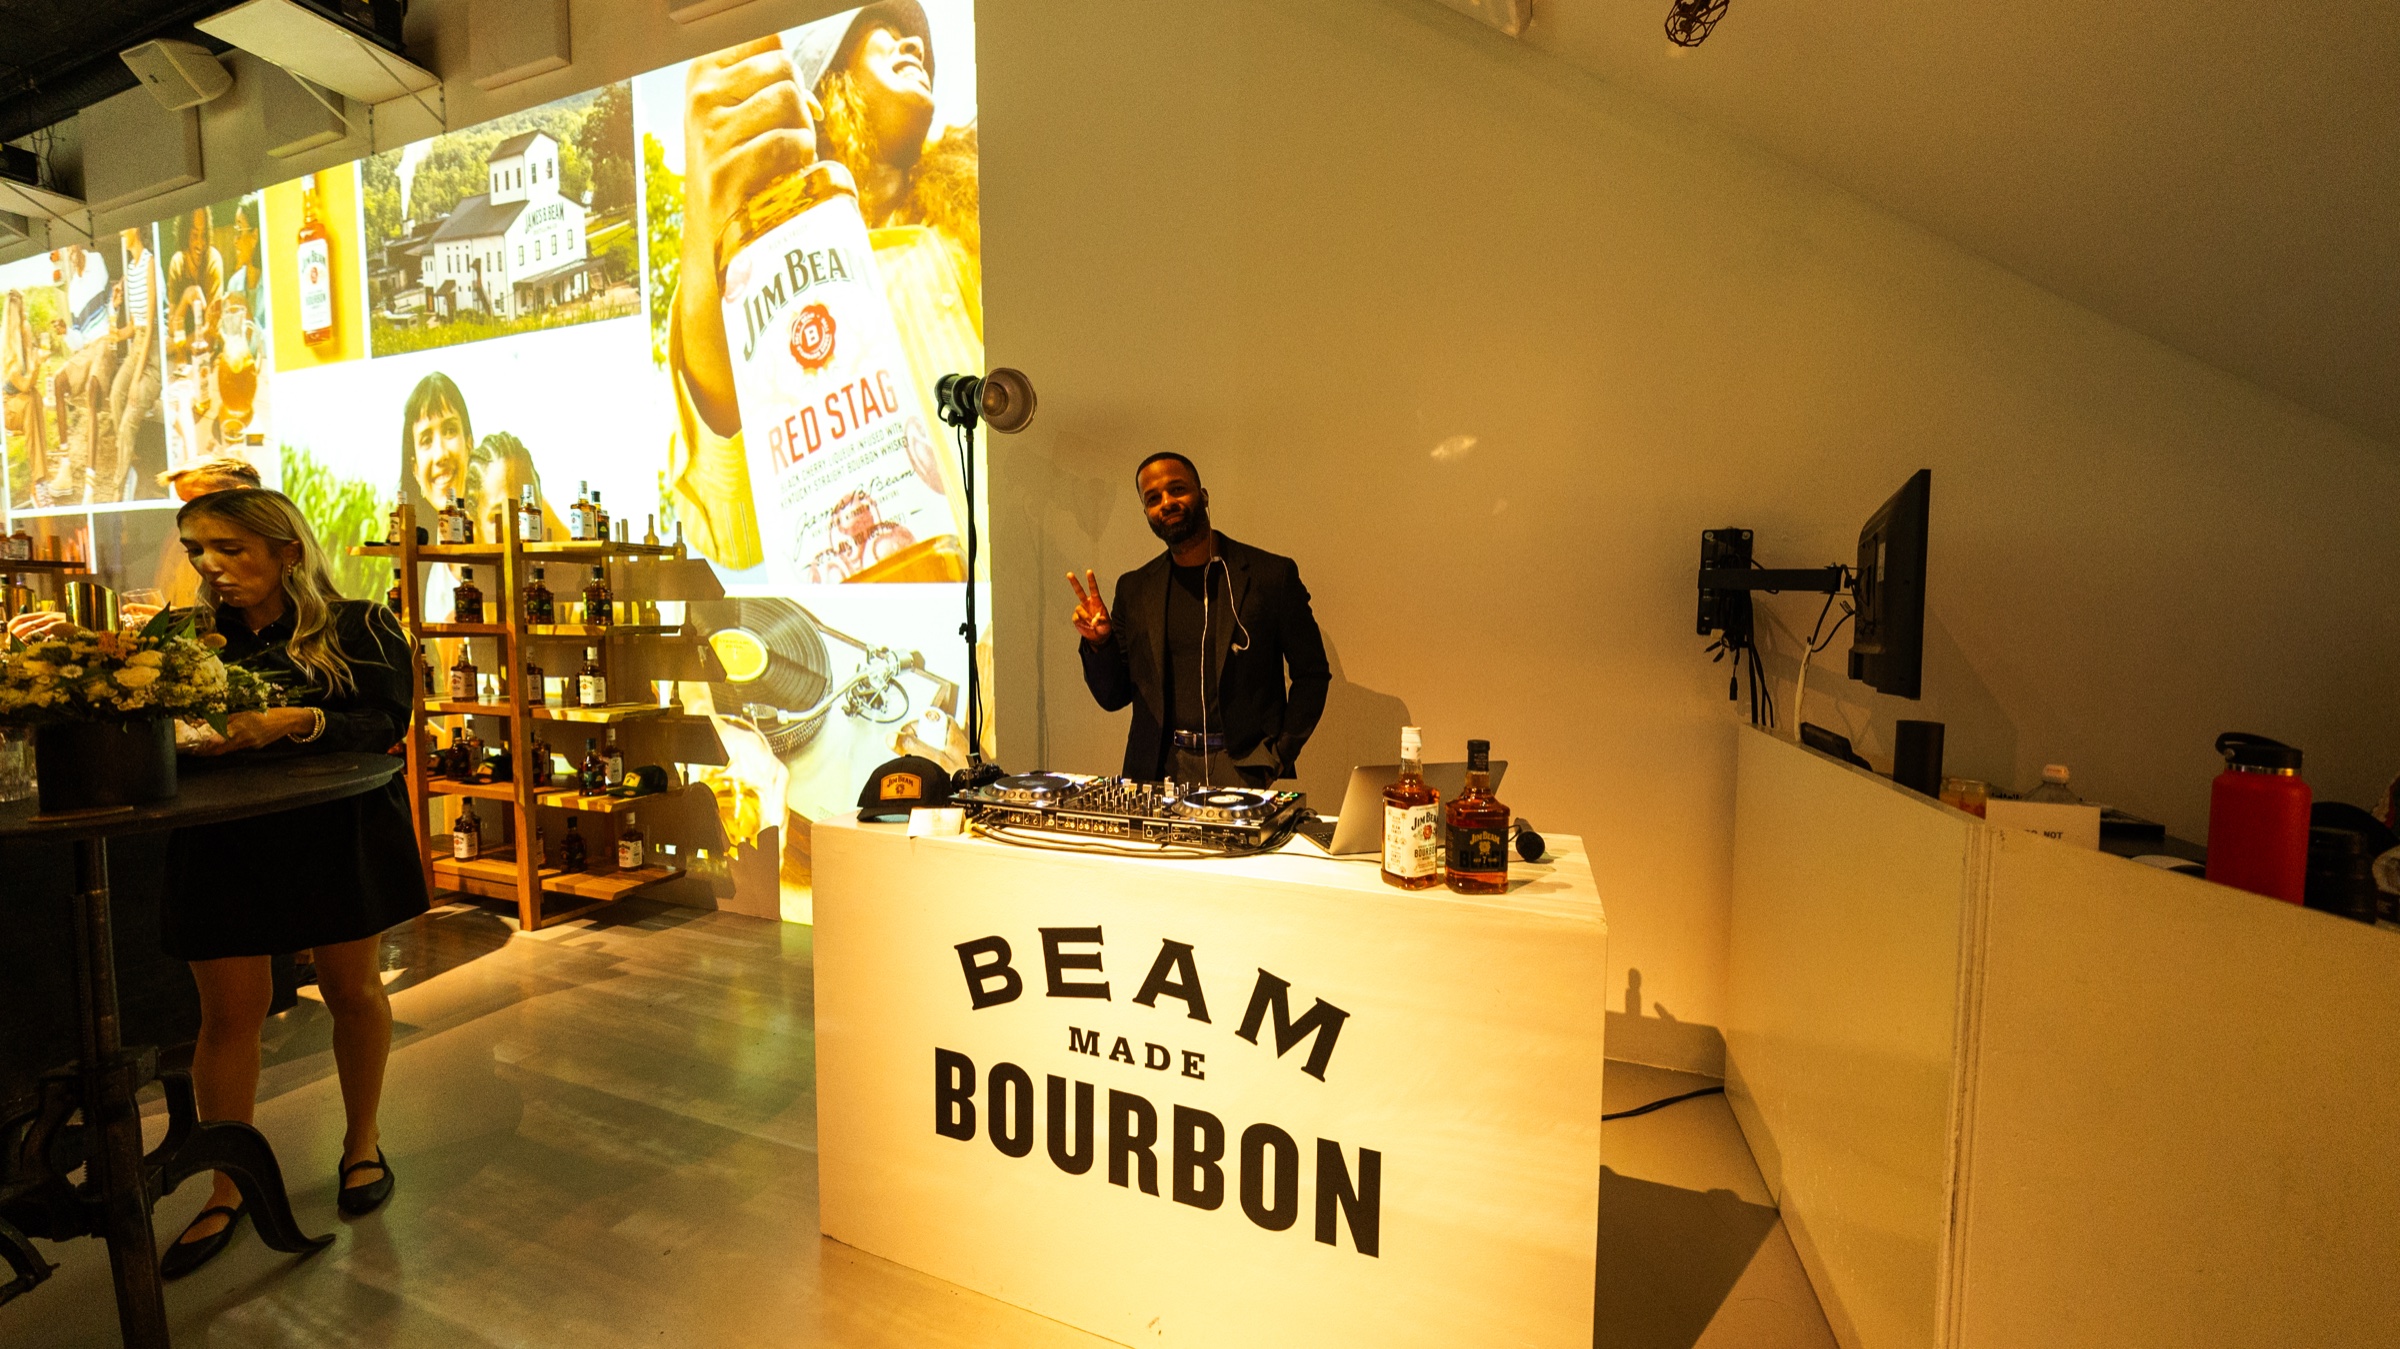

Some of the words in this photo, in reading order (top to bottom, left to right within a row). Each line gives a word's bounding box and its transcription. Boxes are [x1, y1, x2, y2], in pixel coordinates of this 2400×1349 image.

[548, 202, 565, 221] BEAM
[743, 272, 788, 362] JIM
[784, 248, 852, 296] BEA
[804, 324, 819, 347] B
[769, 406, 822, 476] RED
[825, 369, 898, 440] STAG
[802, 460, 826, 481] CHERRY
[829, 443, 856, 467] LIQUEUR
[857, 429, 884, 451] INFUSED
[886, 422, 903, 436] WITH
[813, 465, 845, 491] STRAIGHT
[847, 450, 878, 474] BOURBON
[880, 435, 909, 457] WHISKE
[1411, 816, 1425, 831] JIM
[1470, 833, 1483, 845] JIM
[1483, 831, 1500, 845] BEAM
[1414, 846, 1437, 858] BOURBO
[954, 925, 1351, 1083] BEAM
[1068, 1025, 1206, 1081] MADE
[934, 1046, 1382, 1259] BOURBON
